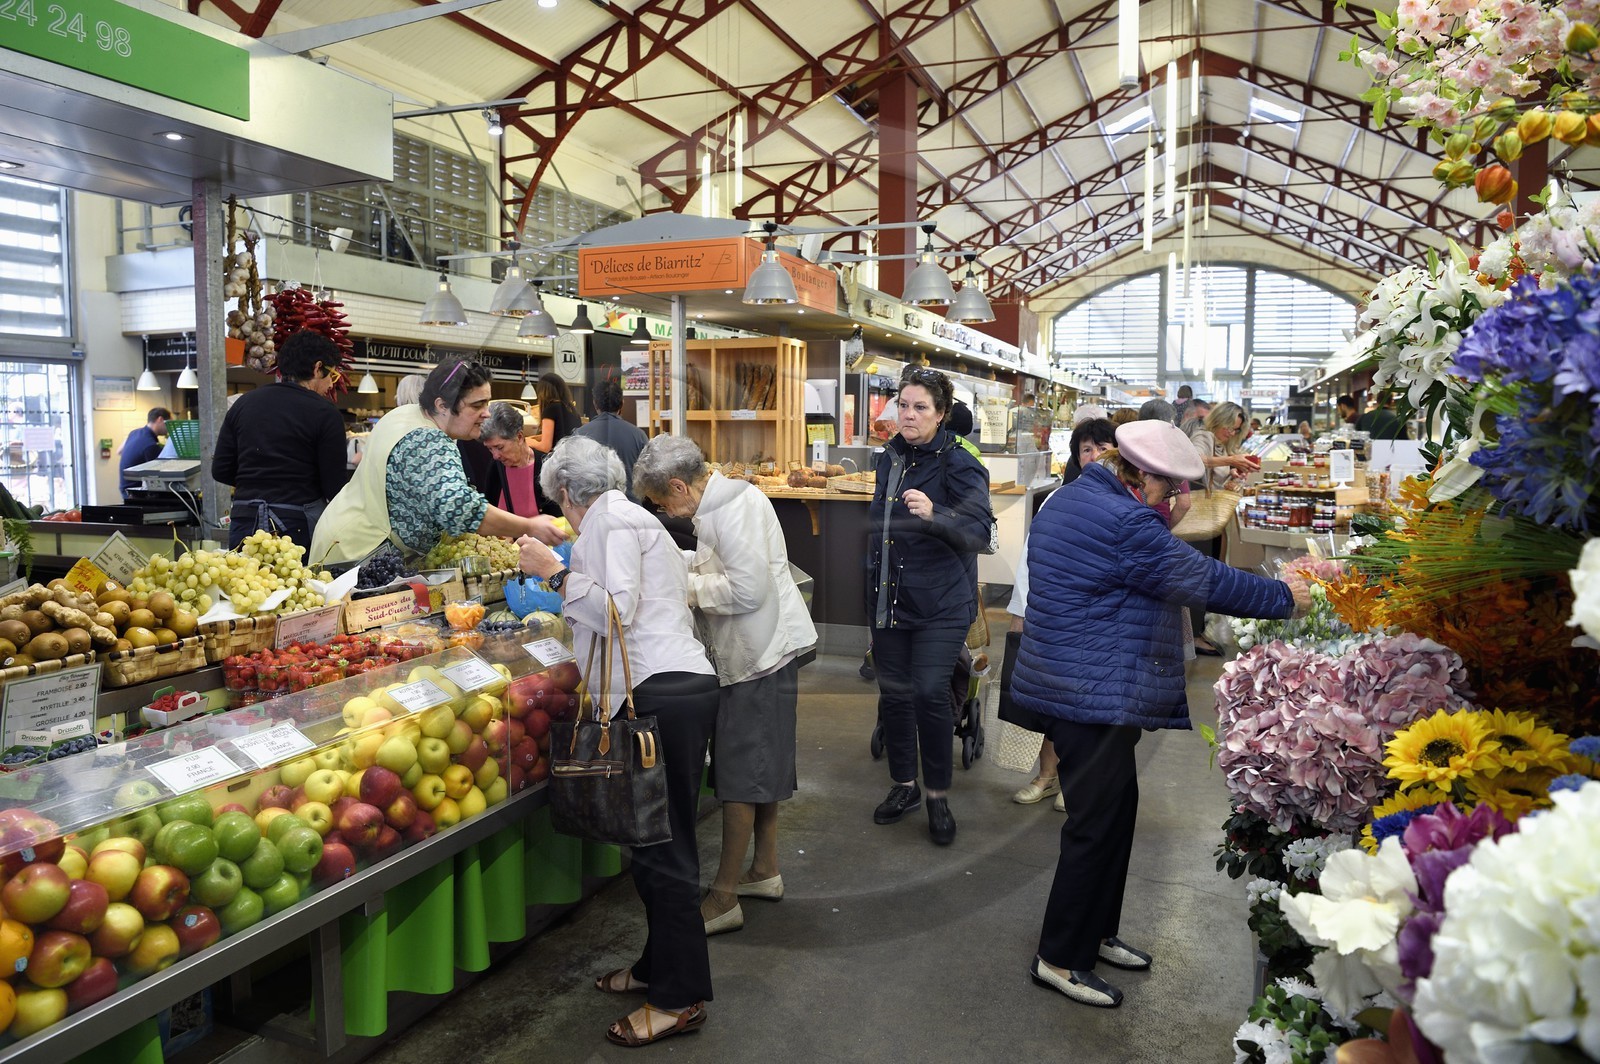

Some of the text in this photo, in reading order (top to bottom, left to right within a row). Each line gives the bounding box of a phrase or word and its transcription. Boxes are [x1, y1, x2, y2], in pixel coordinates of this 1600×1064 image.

[48, 4, 87, 43] 24
[95, 20, 132, 58] 98
[637, 255, 652, 272] de
[791, 266, 828, 289] Boulanger
[368, 345, 381, 358] AU
[364, 595, 411, 614] Saveurs du
[367, 603, 412, 622] Sud-Ouest
[36, 681, 88, 698] FRAMBOISE 2.90
[39, 695, 86, 711] MYRTILLE 3.40
[35, 710, 86, 728] GROSEILLE 4.20
[185, 763, 201, 772] 2.90
[186, 765, 216, 778] FRANCE
